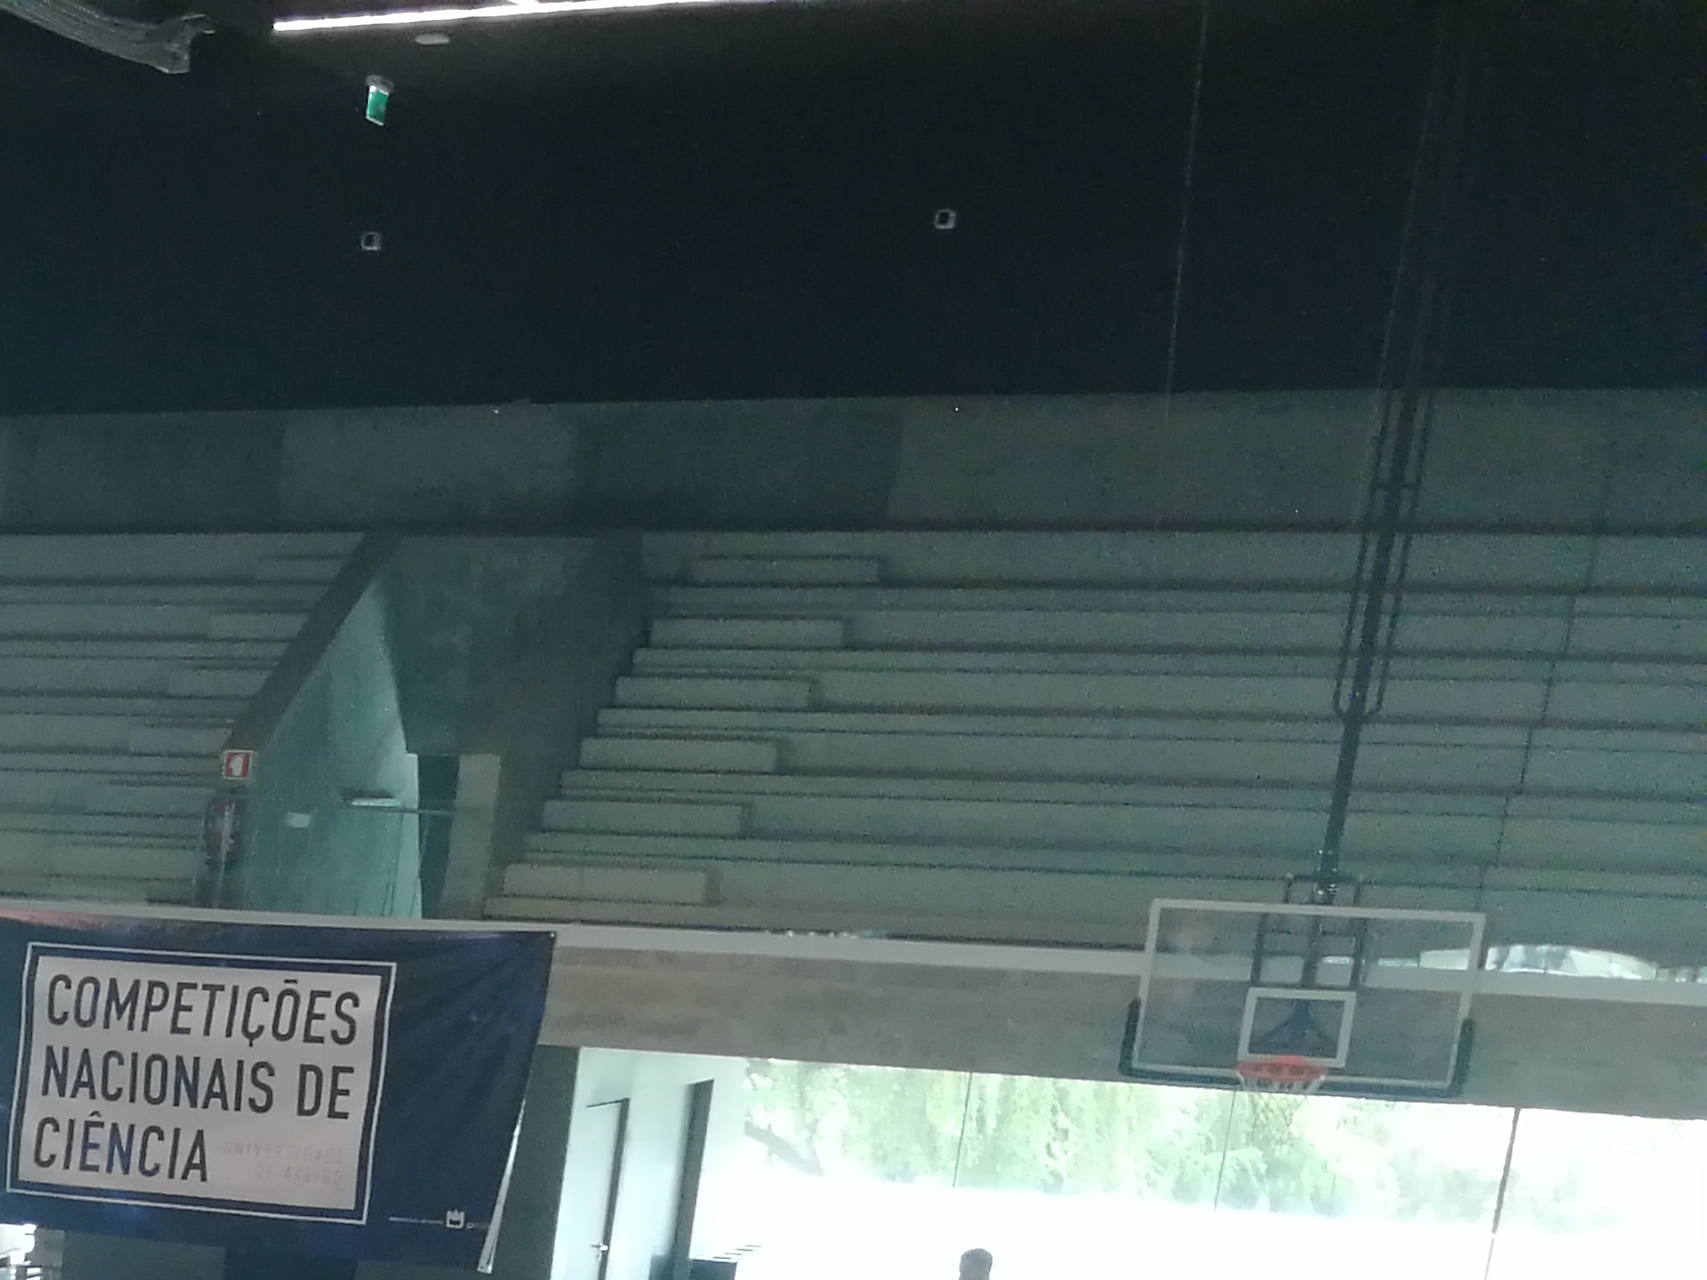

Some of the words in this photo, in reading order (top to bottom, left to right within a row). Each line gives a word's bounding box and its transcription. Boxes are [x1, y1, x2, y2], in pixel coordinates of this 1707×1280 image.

[47, 973, 360, 1047] COMPETIÇÕES
[40, 1045, 275, 1115] NACIONAIS
[294, 1063, 356, 1121] DE
[33, 1109, 209, 1184] CIÊNCIA
